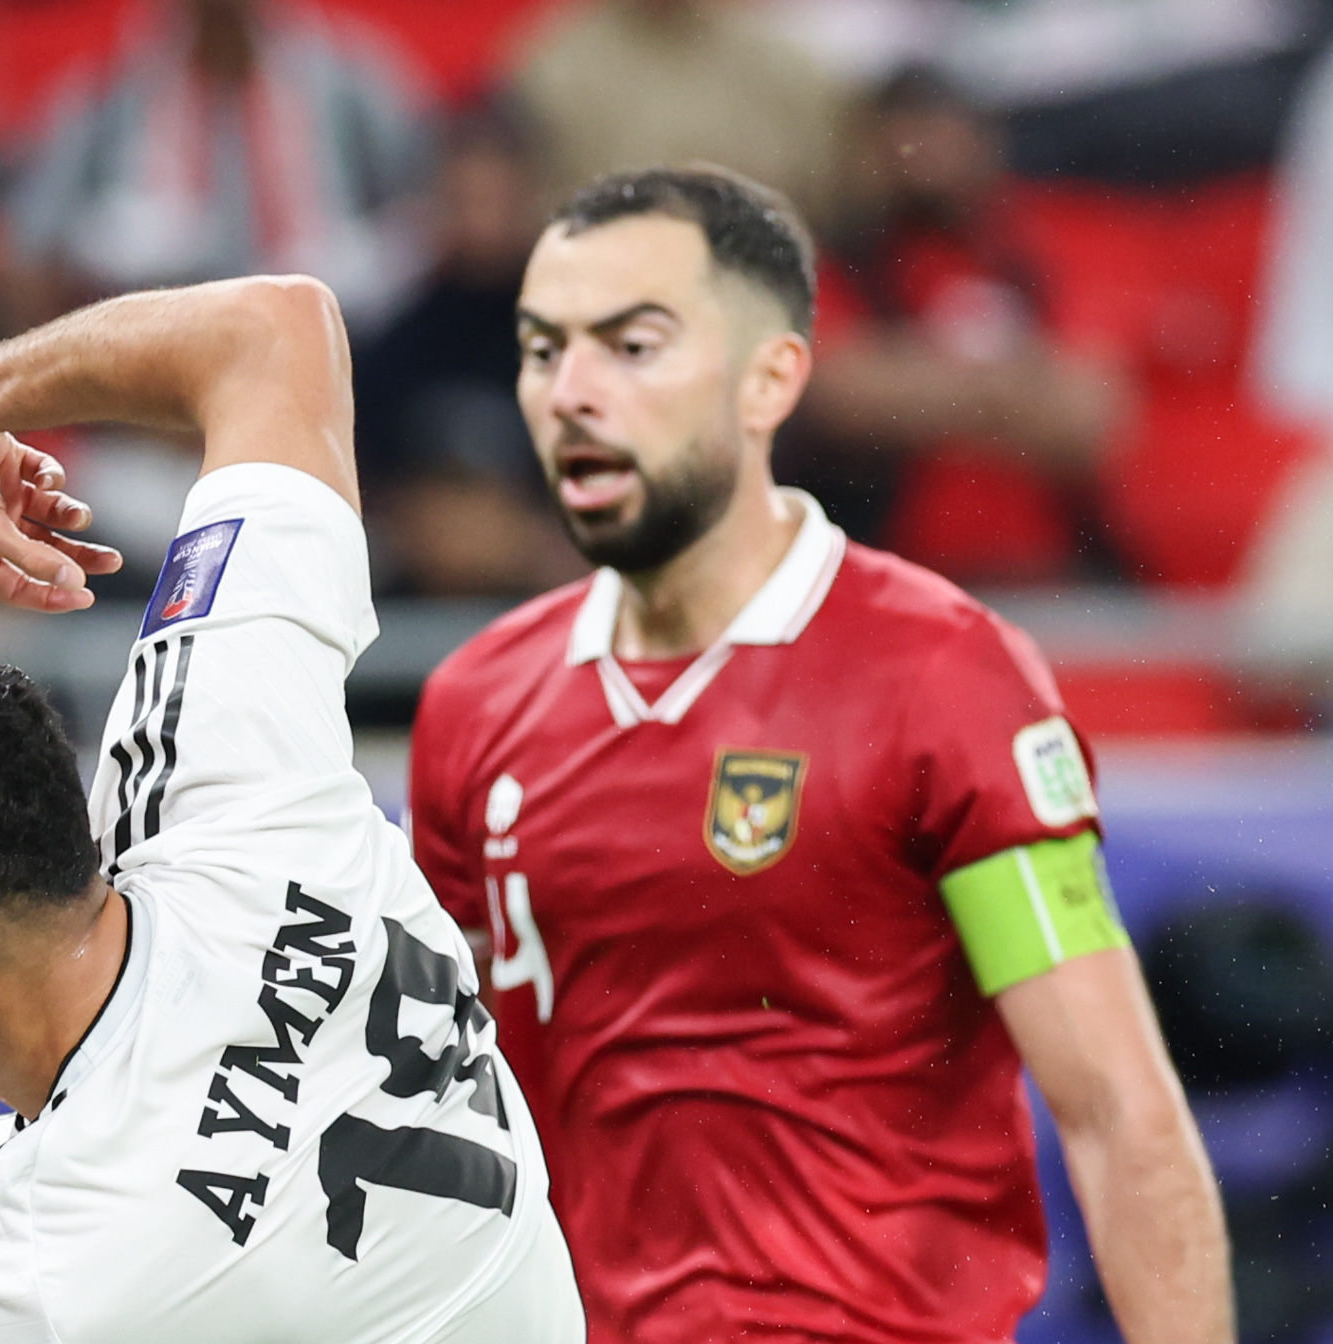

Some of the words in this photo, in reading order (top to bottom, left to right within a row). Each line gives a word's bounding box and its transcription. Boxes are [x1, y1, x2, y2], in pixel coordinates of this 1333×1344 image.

[175, 880, 358, 1248] AYMEN
[317, 915, 517, 1263] 18
[484, 871, 554, 1025] 4
